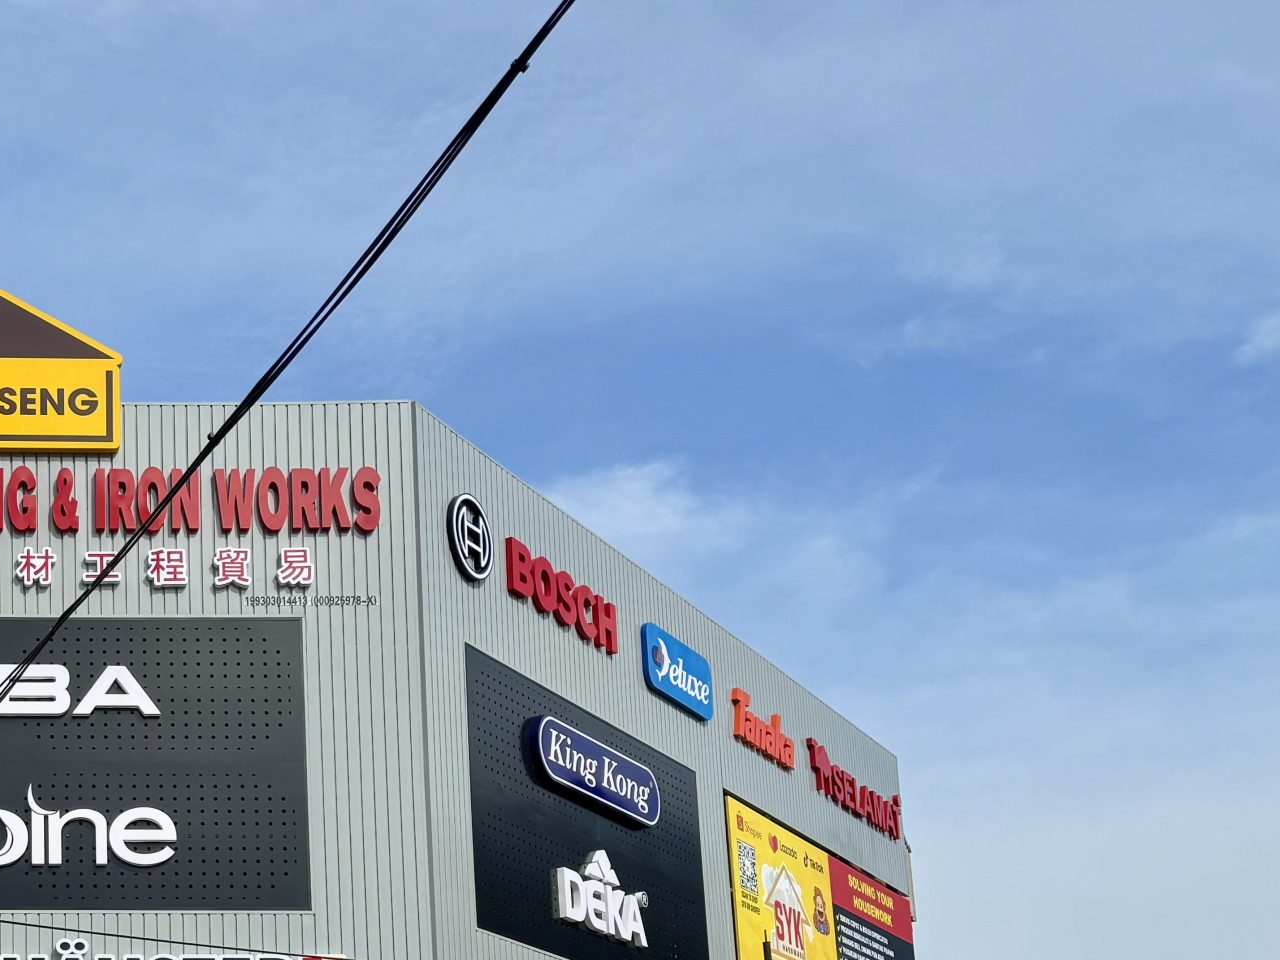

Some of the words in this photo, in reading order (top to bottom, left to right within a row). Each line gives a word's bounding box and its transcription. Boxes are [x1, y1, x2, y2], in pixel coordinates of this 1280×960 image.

[52, 467, 79, 533] &
[95, 466, 200, 534] IRON
[213, 466, 382, 533] WORKS
[505, 537, 618, 655] BOSCH
[731, 687, 795, 769] Tanaka
[548, 728, 598, 788] King
[602, 756, 650, 814] Kong
[556, 867, 648, 948] DEKA
[774, 900, 803, 950] SYK
[847, 873, 876, 900] SOLVING
[876, 890, 894, 910] YOUR
[852, 894, 893, 927] HOUSEWORK
